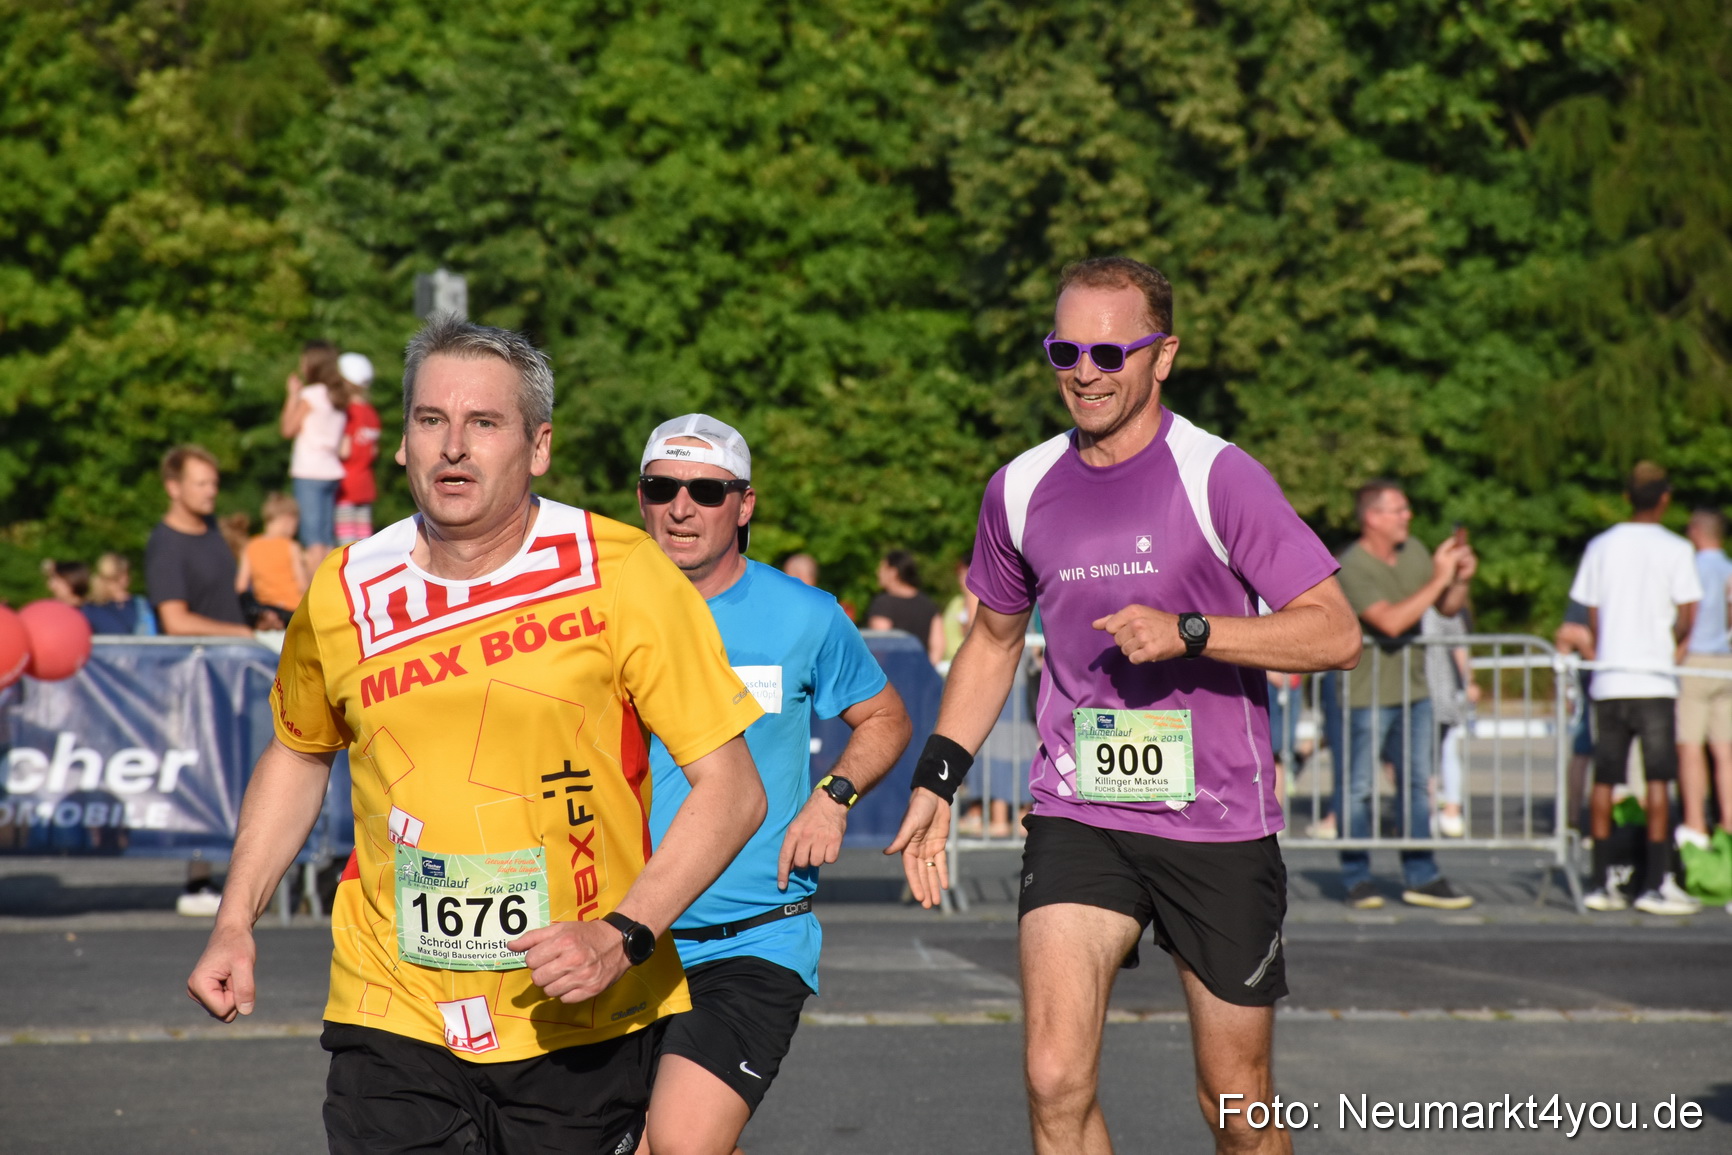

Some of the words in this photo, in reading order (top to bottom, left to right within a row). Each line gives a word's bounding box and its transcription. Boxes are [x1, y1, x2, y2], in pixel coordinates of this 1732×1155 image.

[666, 448, 691, 457] sailfish
[1058, 567, 1086, 582] WIR
[1090, 563, 1120, 578] SIND
[1123, 560, 1159, 575] LILA.
[360, 644, 469, 708] MAX
[480, 606, 606, 666] BÖGL
[1089, 727, 1132, 737] firmenlauf
[1096, 743, 1162, 775] 900
[1095, 777, 1131, 787] Killinger
[413, 871, 470, 889] firmenlauf
[508, 881, 537, 893] 2019
[412, 892, 528, 937] 1676
[420, 935, 462, 950] Schrödl
[417, 946, 431, 955] Max
[433, 949, 450, 959] Bögl
[452, 951, 497, 959] Bauservice
